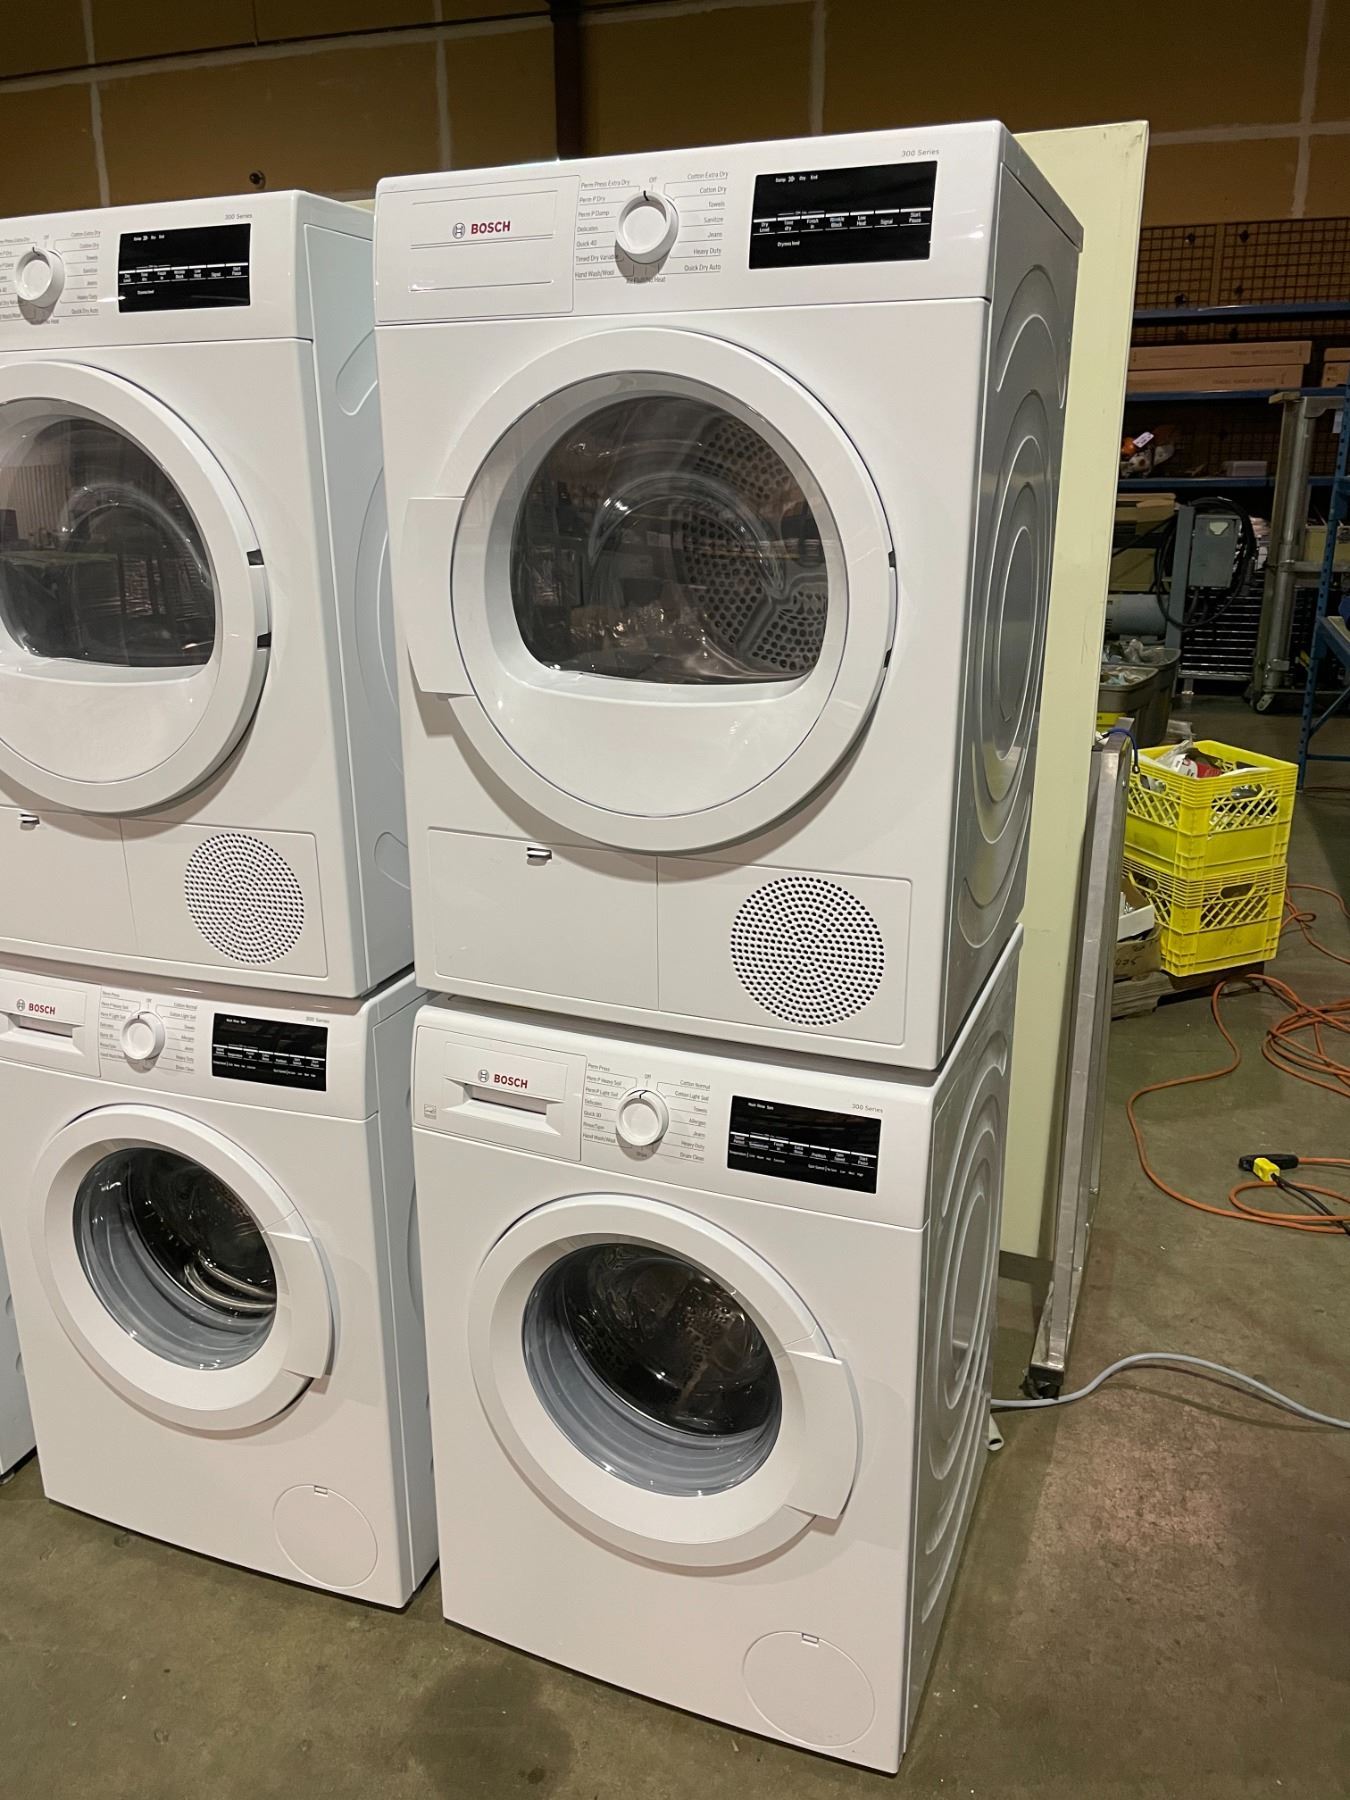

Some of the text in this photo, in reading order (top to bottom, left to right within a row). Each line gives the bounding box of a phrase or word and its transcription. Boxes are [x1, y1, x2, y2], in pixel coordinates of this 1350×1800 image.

[901, 150, 916, 158] 300
[471, 220, 511, 235] BOSCH
[694, 248, 708, 256] Heavy
[684, 264, 698, 272] Quick
[28, 1003, 56, 1015] BOSCH
[494, 1074, 528, 1089] BOSCH
[865, 1105, 883, 1113] Series
